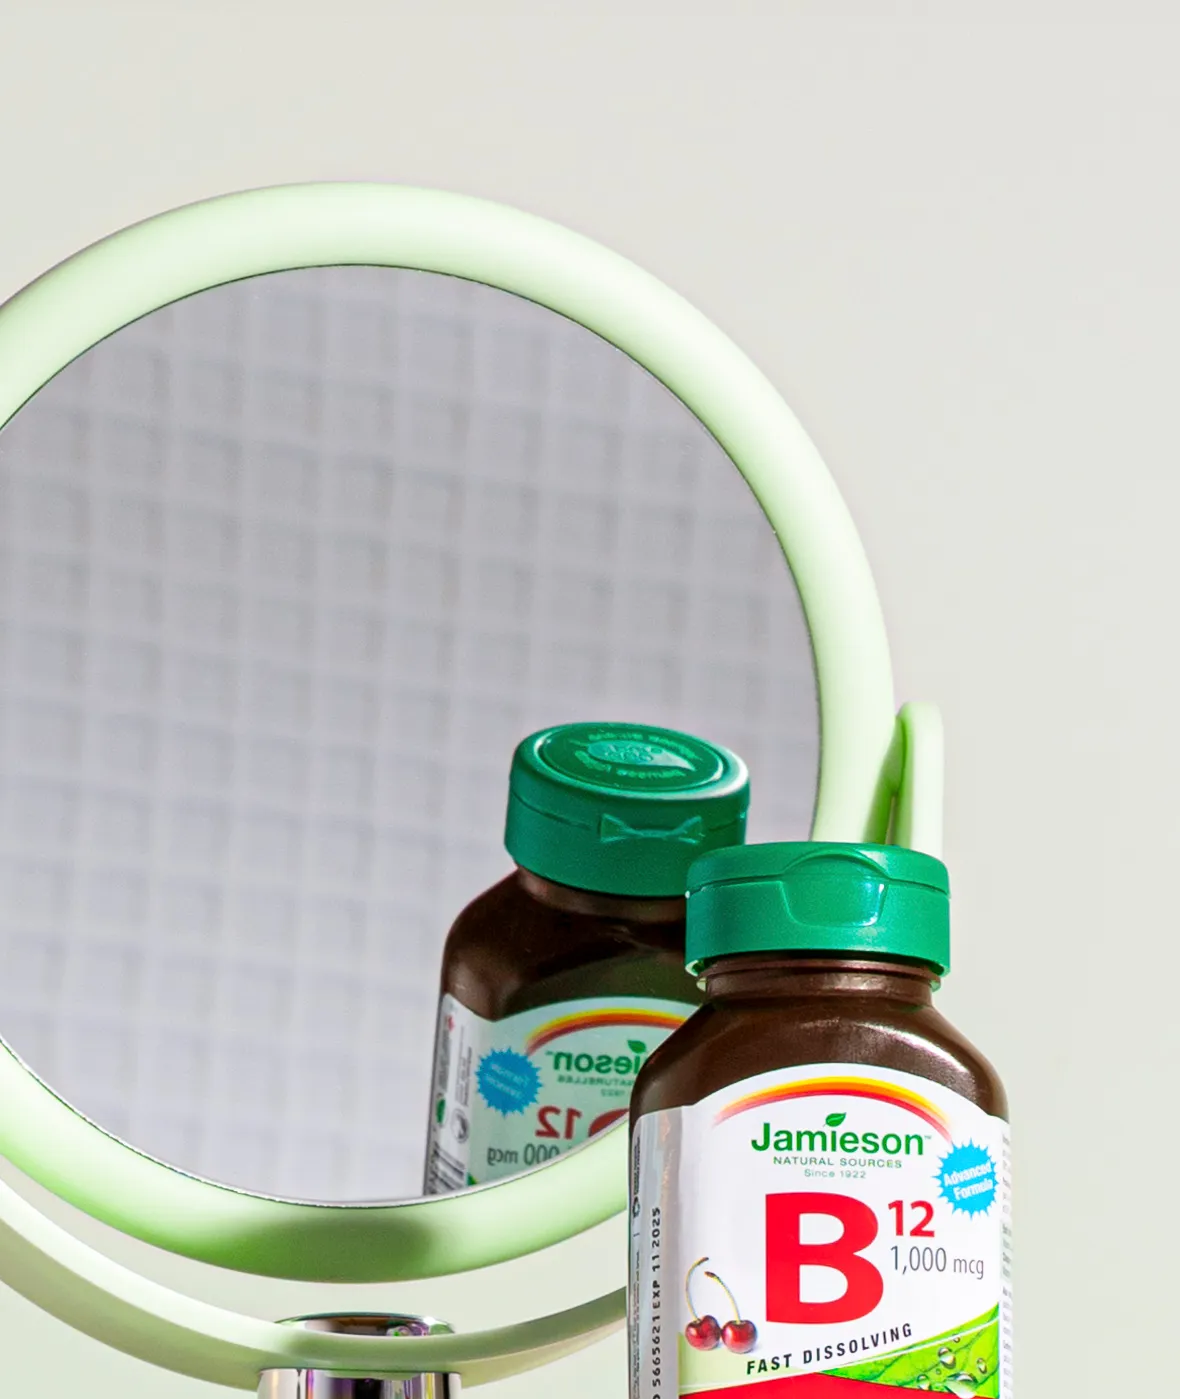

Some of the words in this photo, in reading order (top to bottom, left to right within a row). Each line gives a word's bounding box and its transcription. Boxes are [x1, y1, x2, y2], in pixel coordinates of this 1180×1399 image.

[751, 1122, 924, 1156] Jamieson
[773, 1156, 834, 1167] NATURAL
[840, 1157, 902, 1169] SOURCES
[804, 1168, 835, 1178] Since
[841, 1169, 867, 1179] 1922
[943, 1160, 992, 1187] Advanced
[953, 1177, 994, 1201] Formula
[651, 1207, 662, 1248] 2025
[652, 1253, 662, 1272] 11
[765, 1192, 884, 1326] B
[888, 1200, 935, 1238] 12
[890, 1245, 947, 1276] 1,000
[953, 1256, 985, 1280] mcg
[652, 1280, 662, 1309] EXP
[746, 1353, 793, 1375] FAST
[803, 1323, 913, 1364] DISSOLVING
